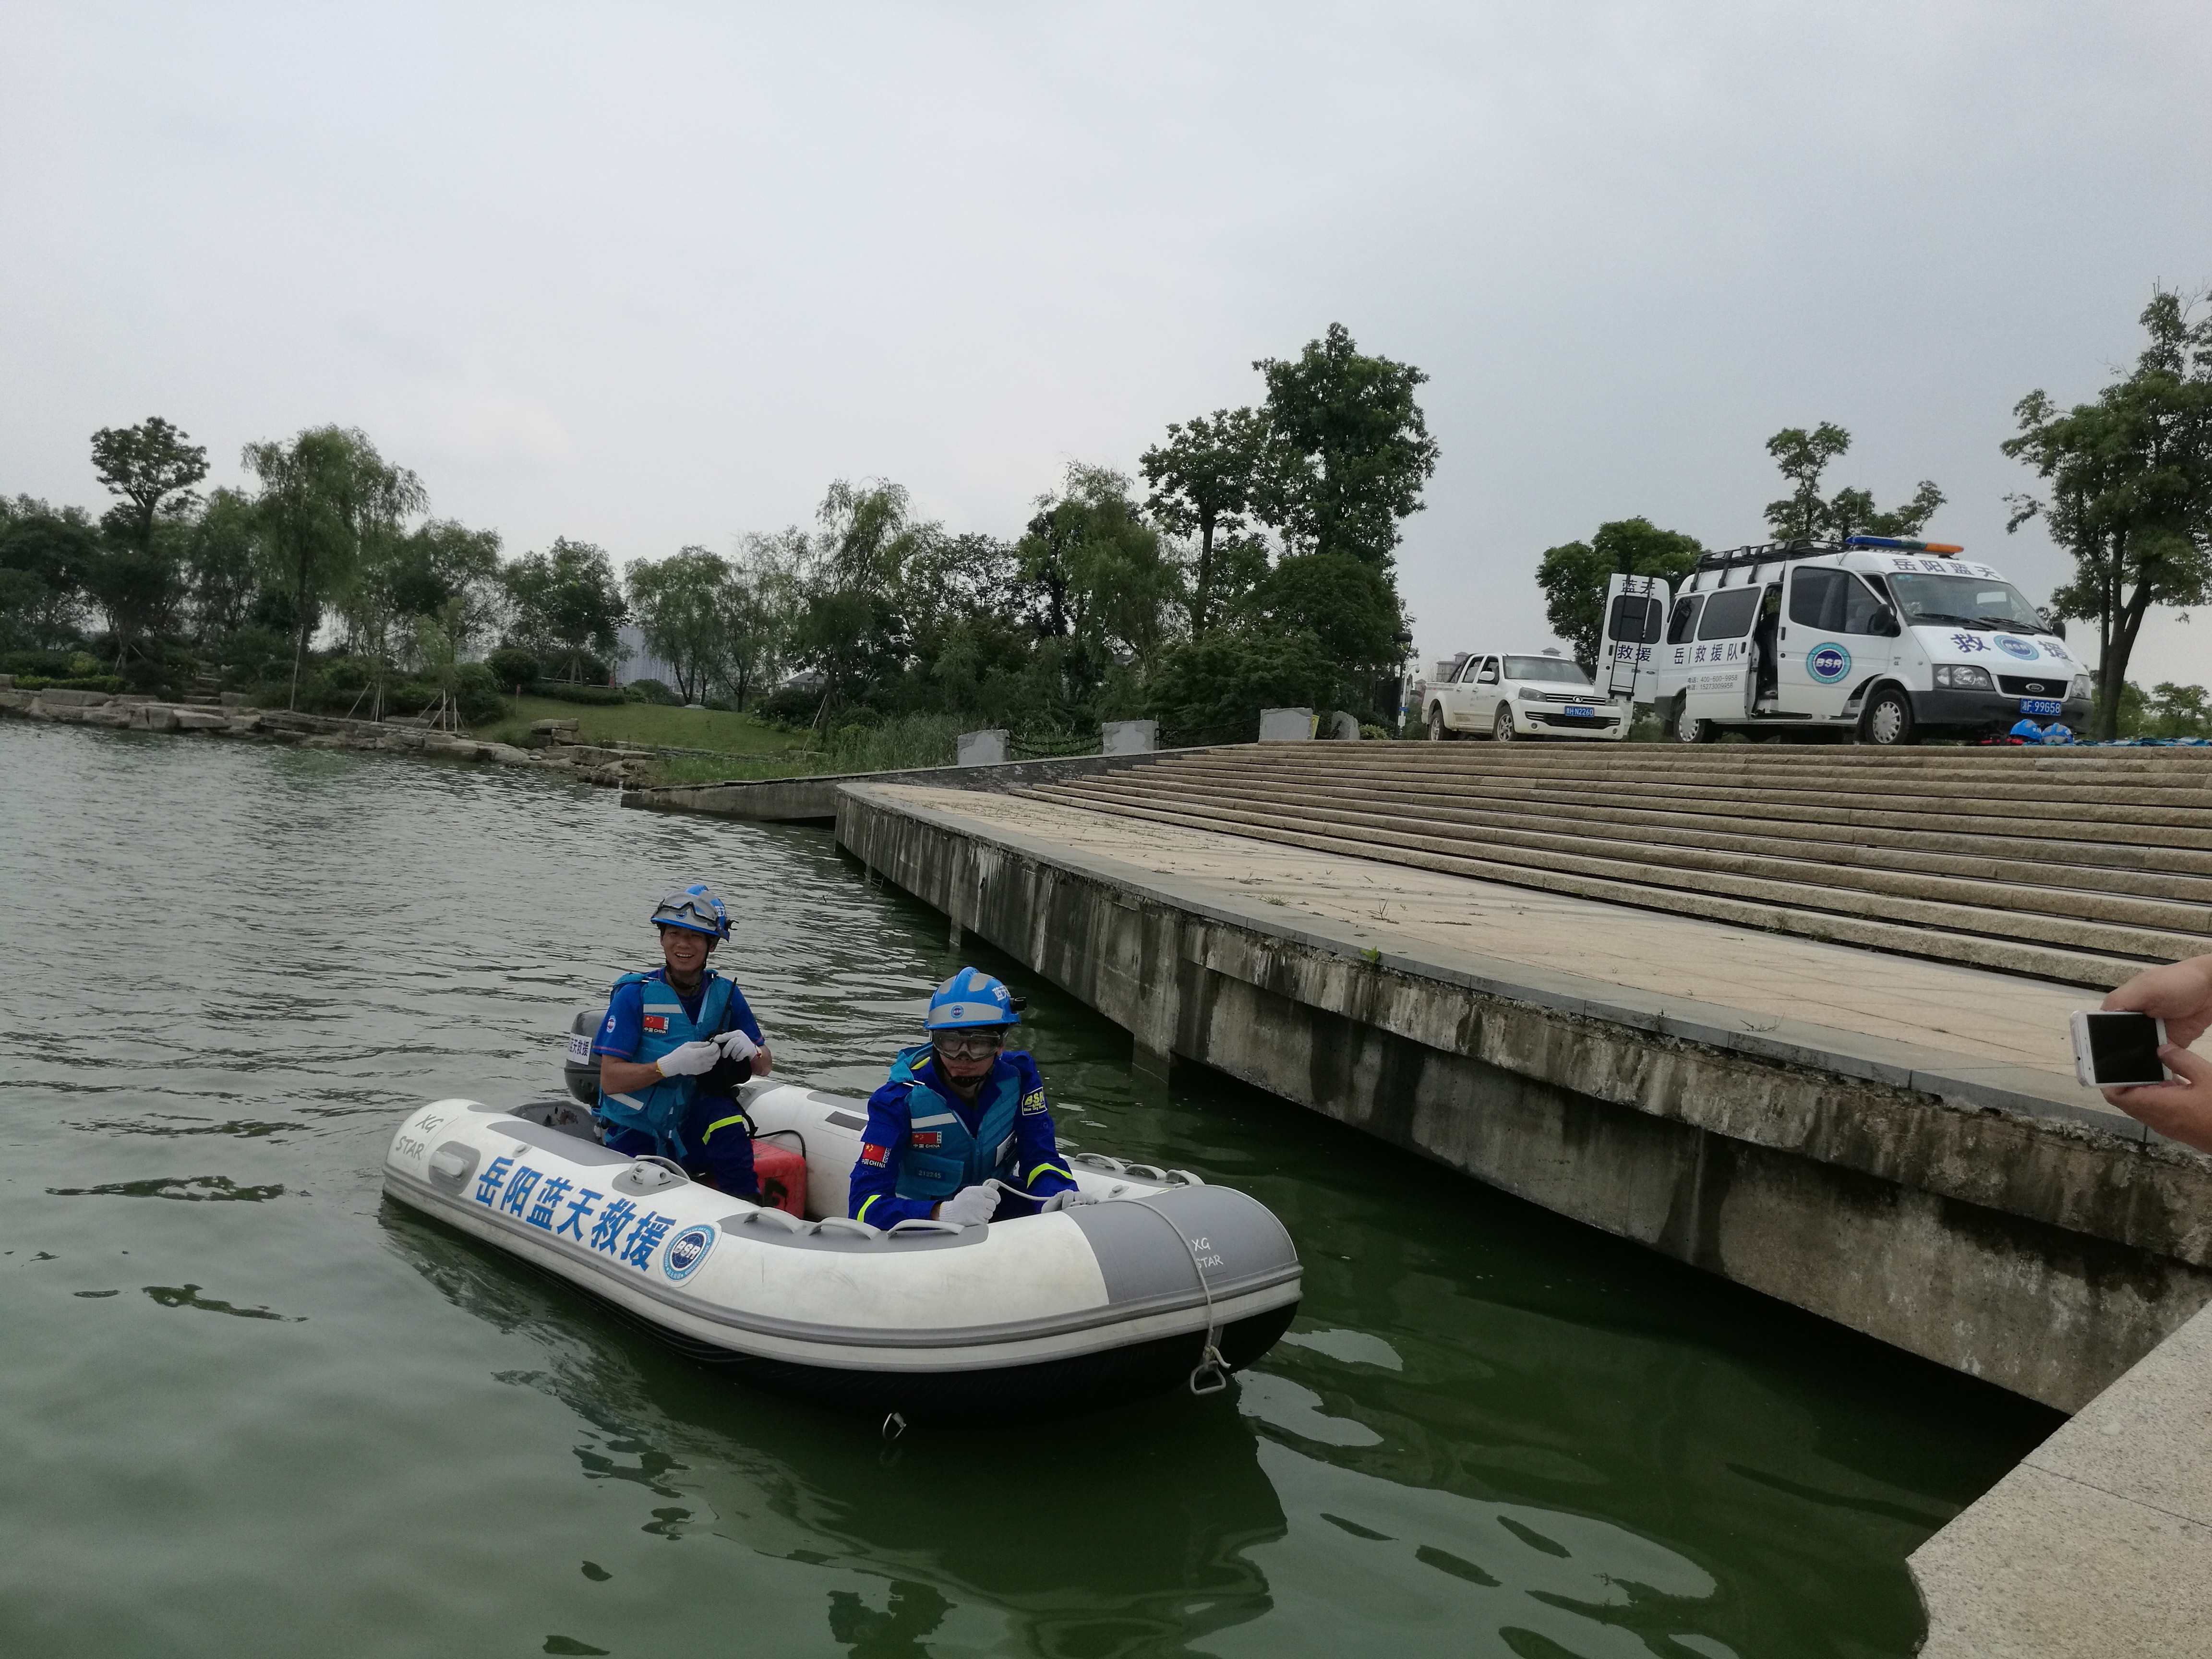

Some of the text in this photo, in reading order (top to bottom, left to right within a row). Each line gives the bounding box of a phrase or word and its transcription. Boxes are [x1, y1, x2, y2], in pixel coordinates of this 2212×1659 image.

[1891, 558, 2001, 580] 岳阳蓝天
[1621, 579, 1656, 595] 蓝天
[1617, 644, 1652, 662] 救援
[1950, 633, 2074, 662] 救 援
[1815, 658, 1842, 669] BSR
[1700, 674, 1738, 683] 400-600-9958
[1024, 1091, 1045, 1106] BSR
[415, 1114, 445, 1133] XG
[396, 1135, 425, 1161] STAR
[869, 1160, 886, 1168] CHINA
[918, 1170, 941, 1179] 212245
[476, 1156, 677, 1272] 岳阳蓝天救援
[673, 1240, 701, 1260] BSR
[1191, 1237, 1211, 1252] XG
